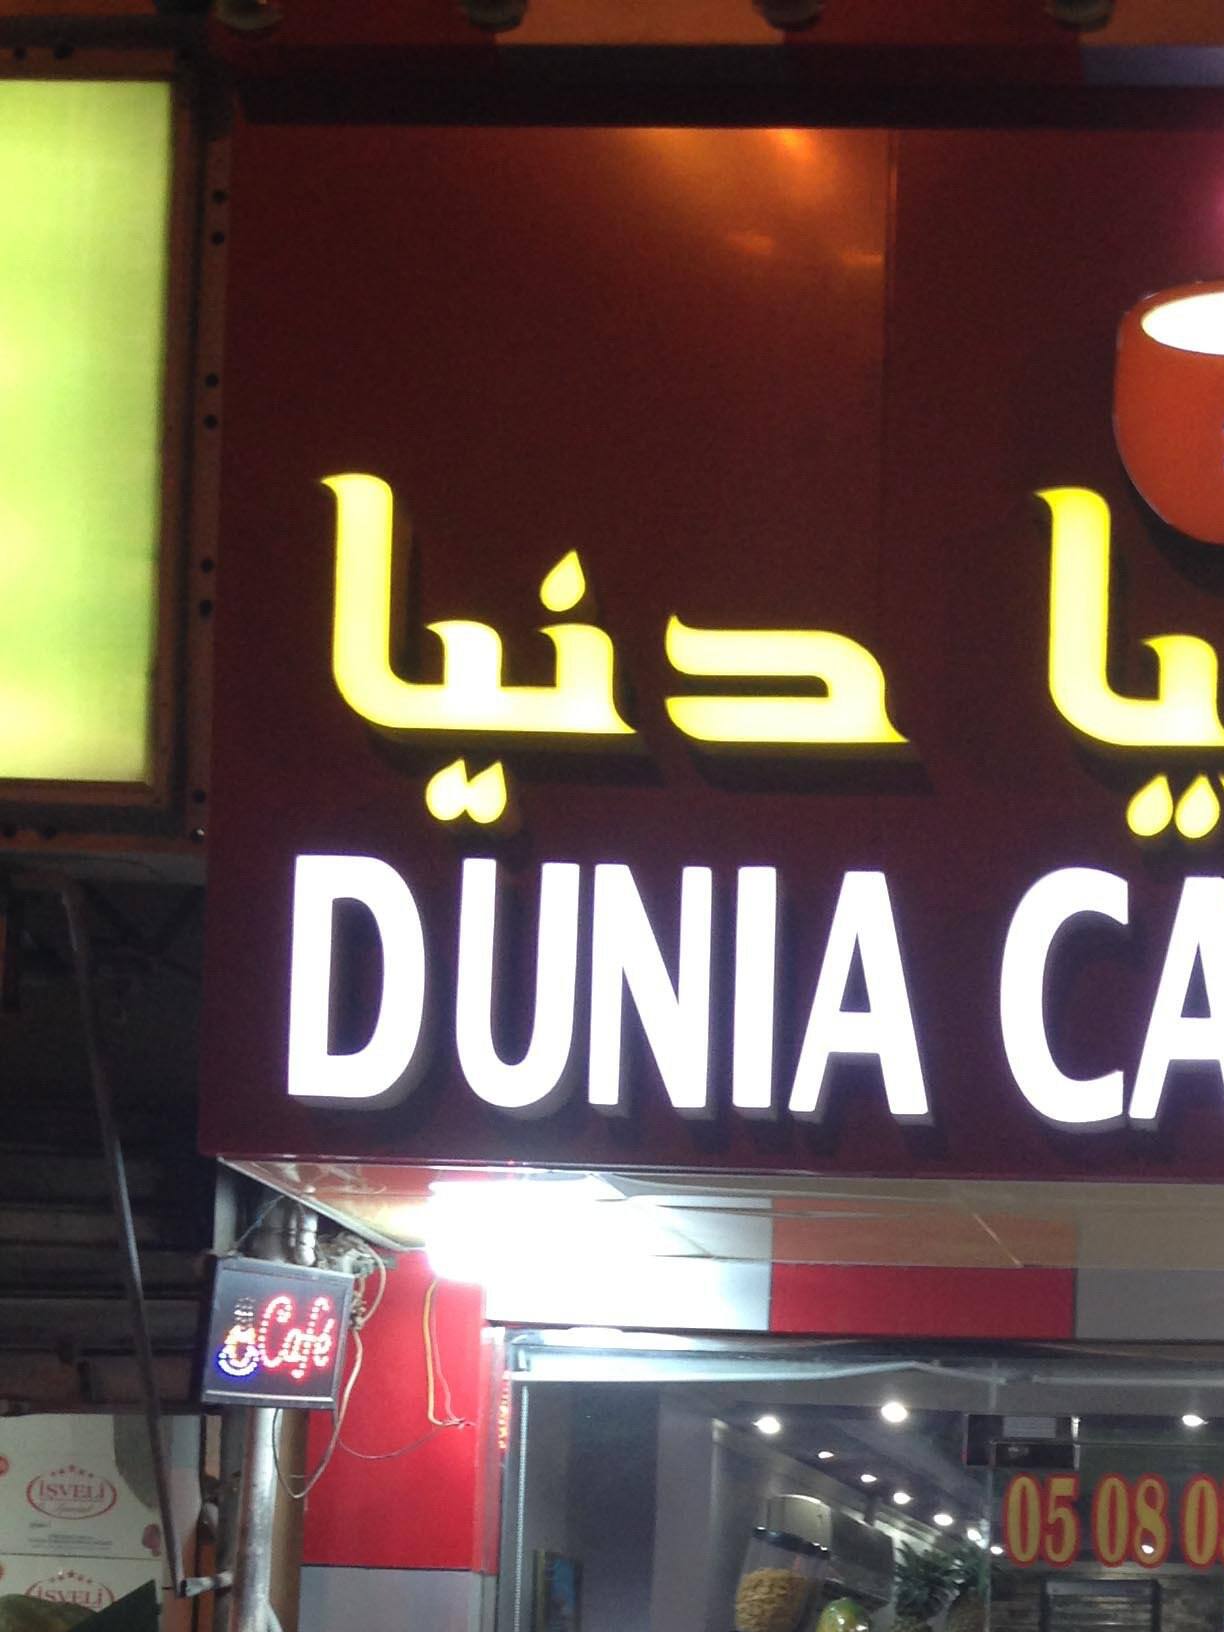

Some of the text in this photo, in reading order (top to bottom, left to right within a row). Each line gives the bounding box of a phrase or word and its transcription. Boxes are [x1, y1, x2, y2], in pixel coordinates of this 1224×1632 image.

[320, 473, 911, 823] دنيا
[287, 854, 930, 1116] DUNIA
[1005, 1473, 1081, 1568] 05
[1093, 1474, 1169, 1569] 08
